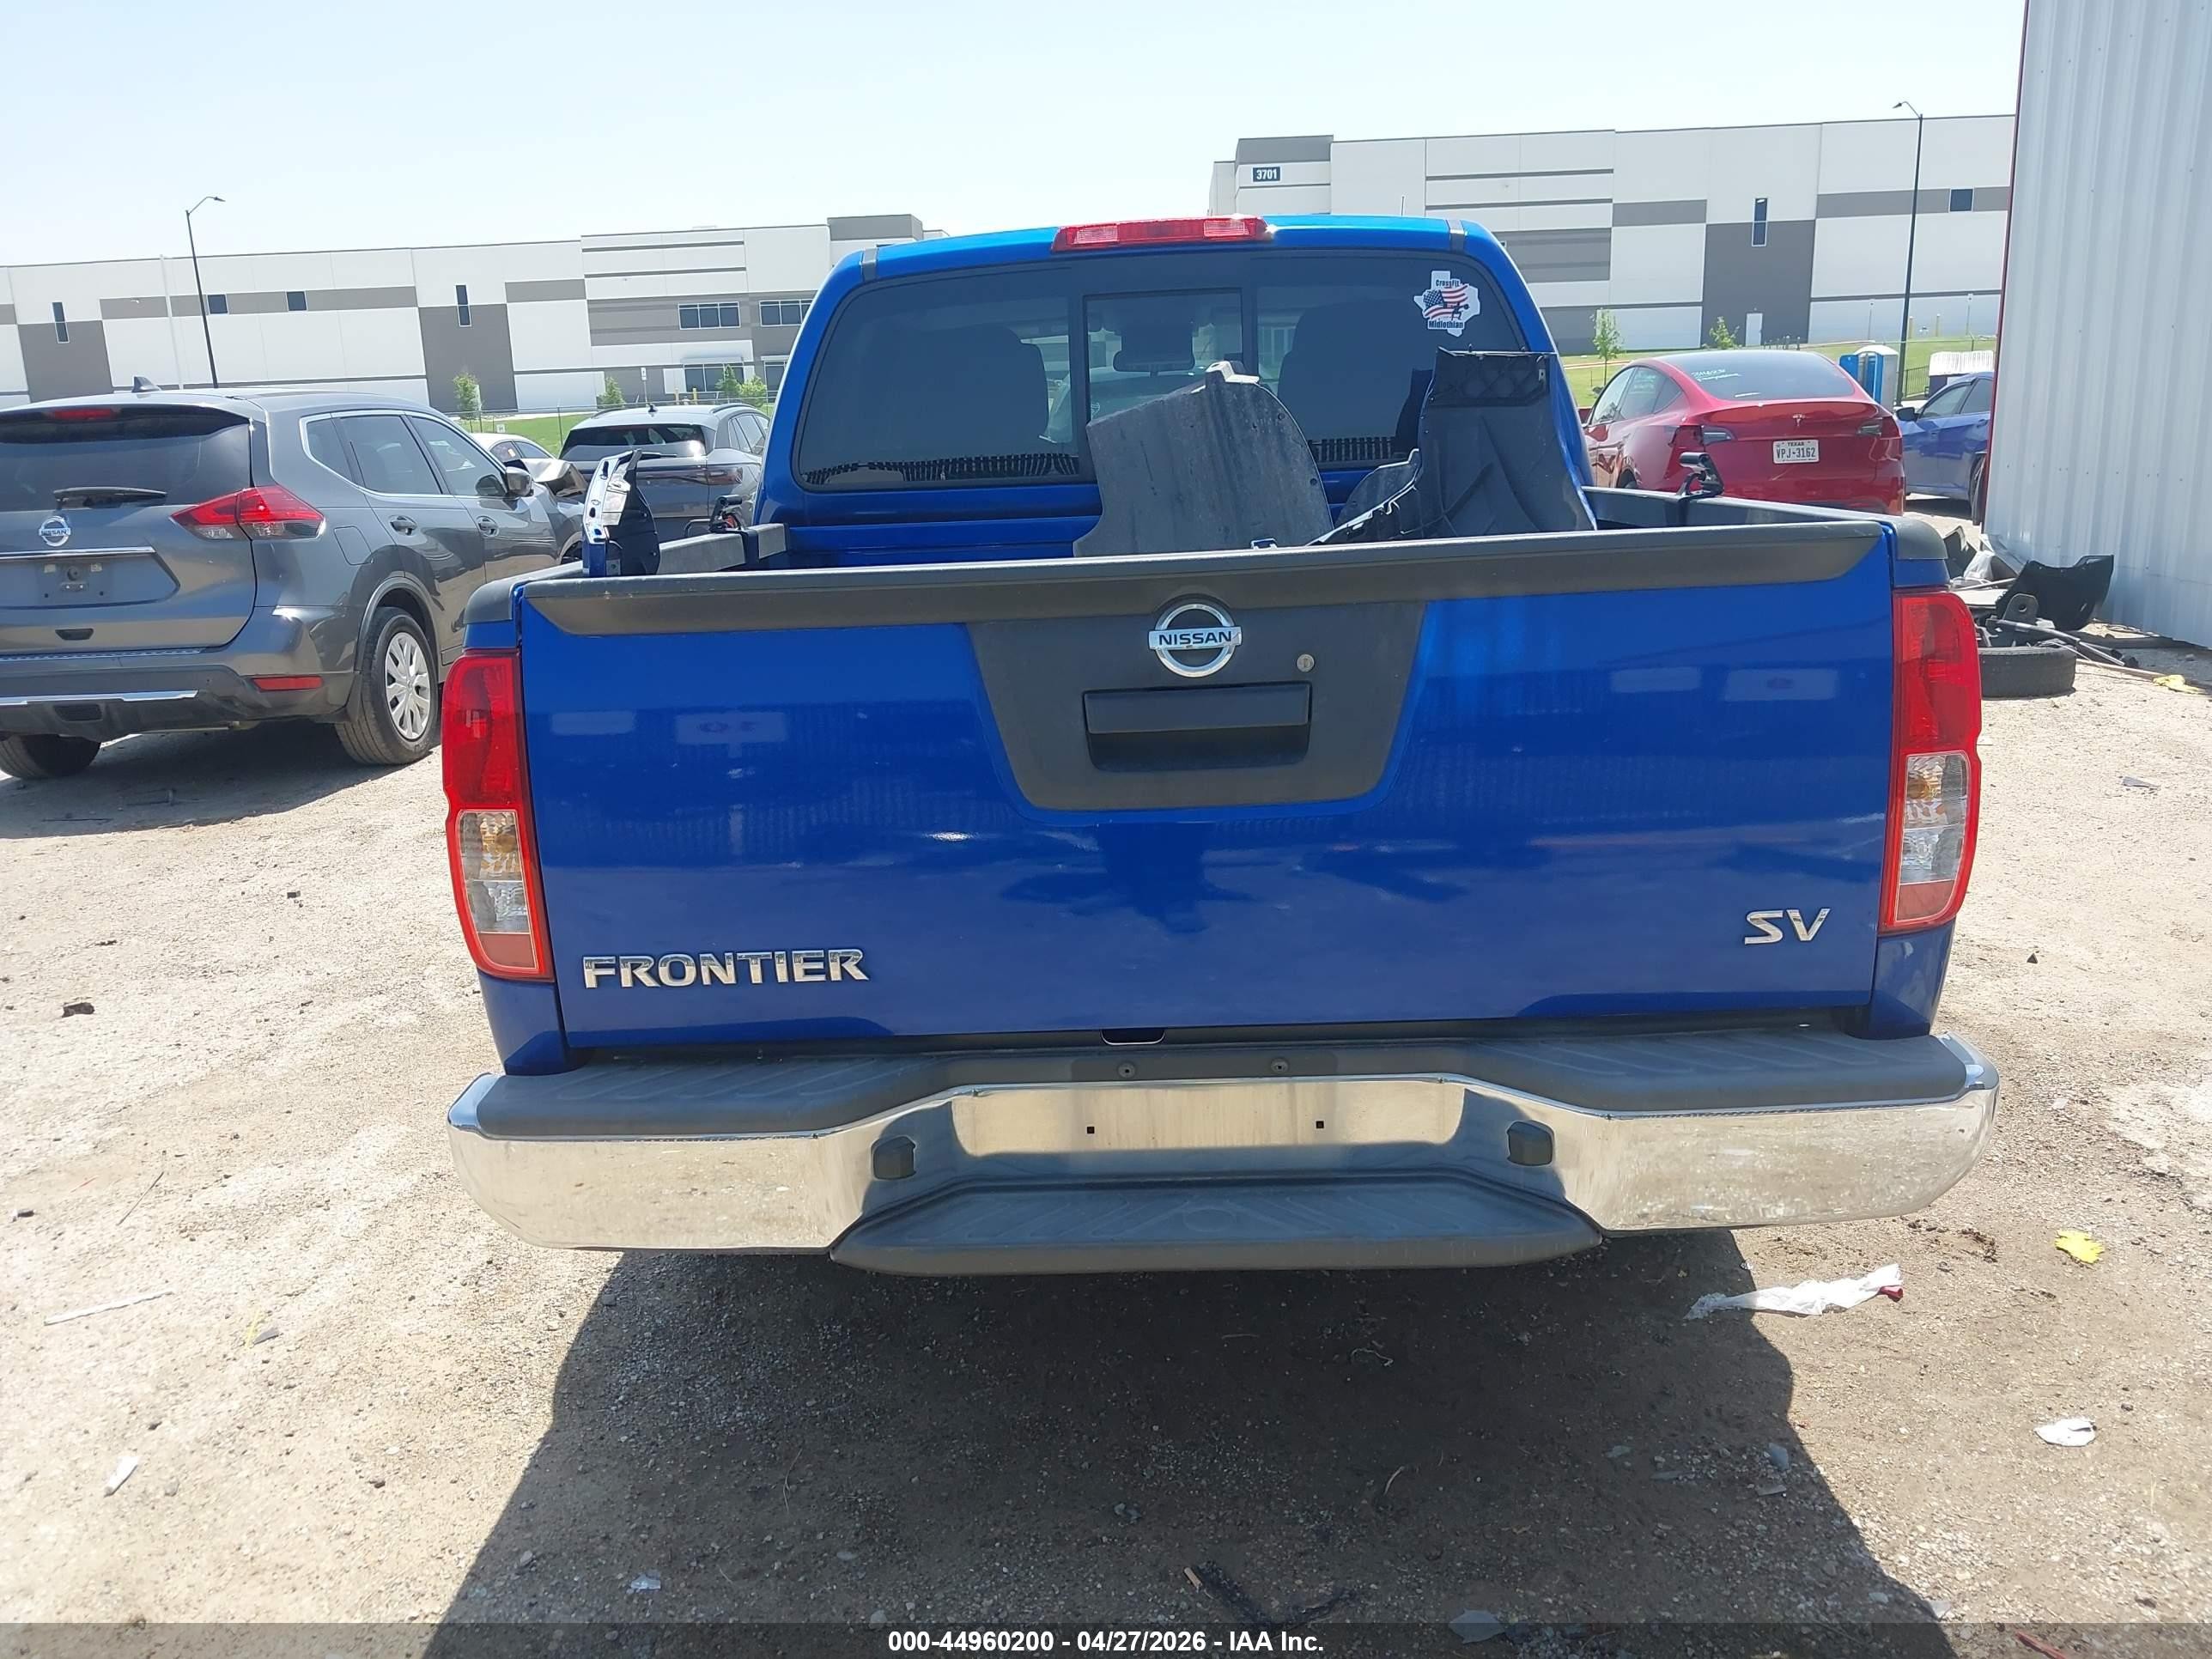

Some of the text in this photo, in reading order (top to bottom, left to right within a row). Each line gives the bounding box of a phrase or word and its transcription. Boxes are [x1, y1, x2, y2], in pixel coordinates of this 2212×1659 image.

[1256, 169, 1278, 179] 3701
[1428, 320, 1463, 329] Midlothian
[1159, 631, 1232, 646] NISSAN
[1744, 908, 1831, 945] SV
[582, 948, 870, 988] FRONTIER
